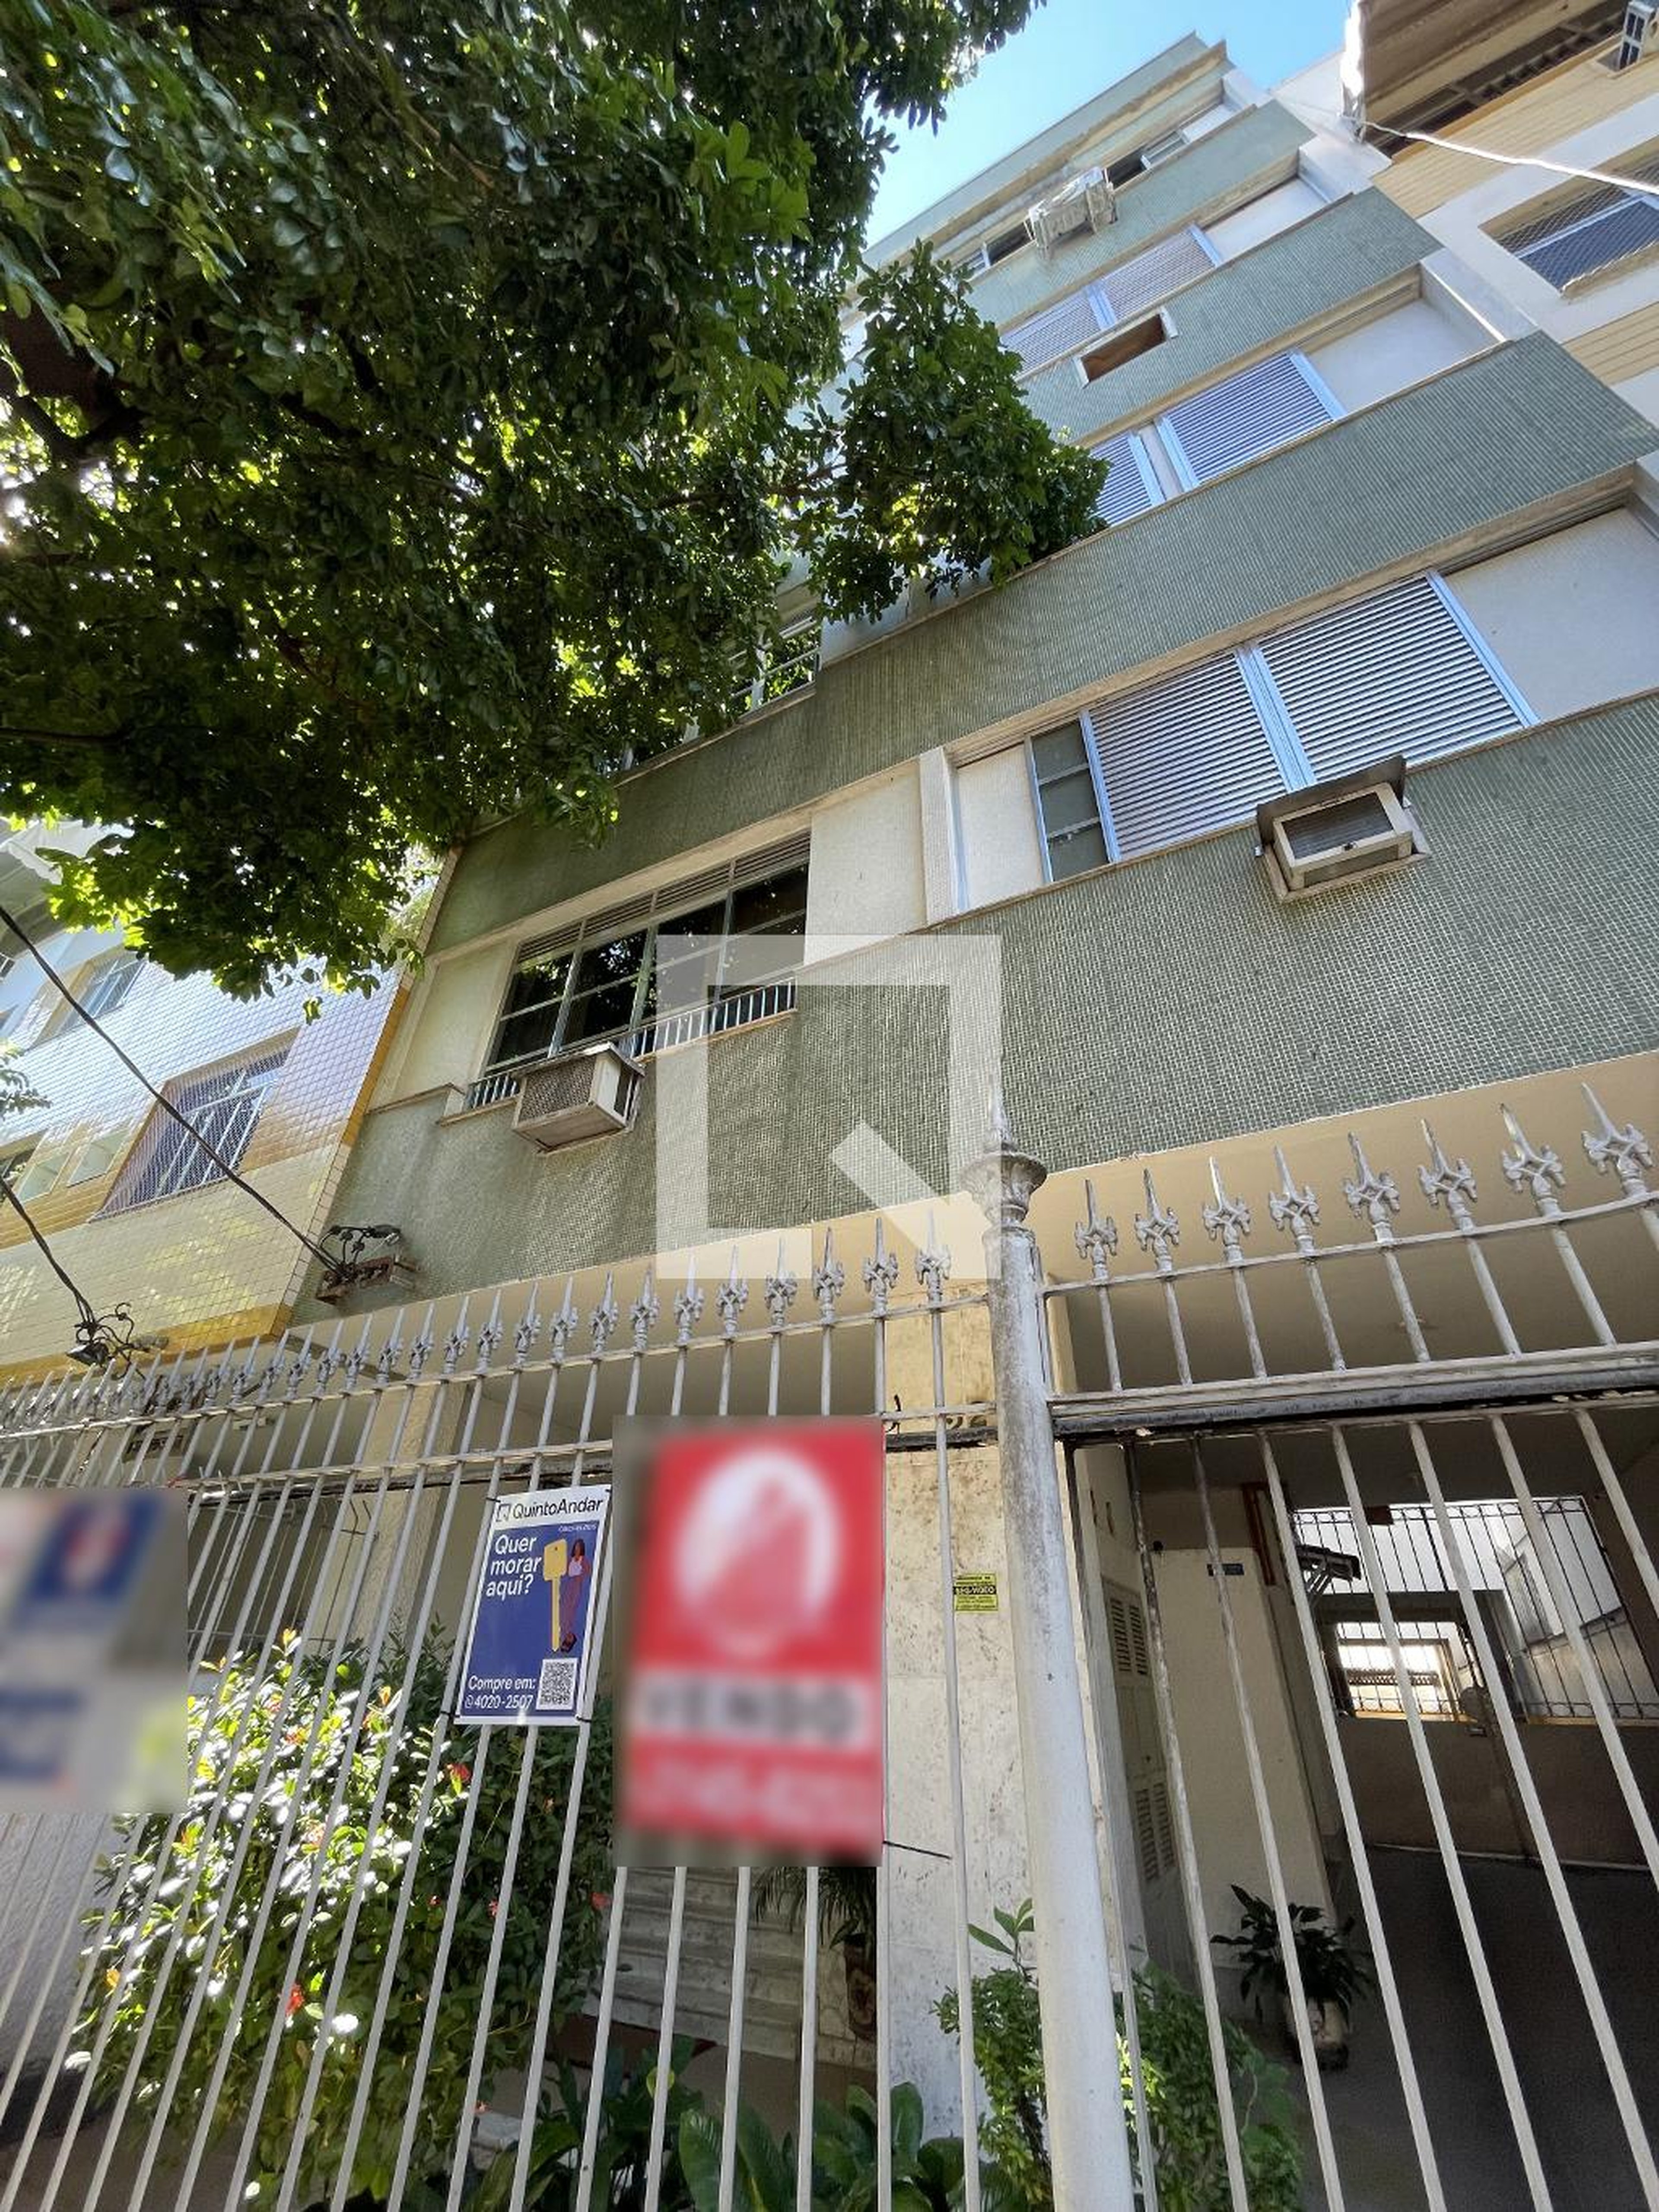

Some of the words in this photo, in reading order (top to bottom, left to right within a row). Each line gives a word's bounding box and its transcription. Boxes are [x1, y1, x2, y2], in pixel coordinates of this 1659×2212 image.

[513, 1497, 603, 1519] QuintoAndar
[495, 1534, 537, 1555] Quer
[490, 1556, 542, 1575] morar
[486, 1573, 534, 1601] aqui?
[468, 1675, 512, 1693] Compre
[515, 1678, 536, 1689] em:
